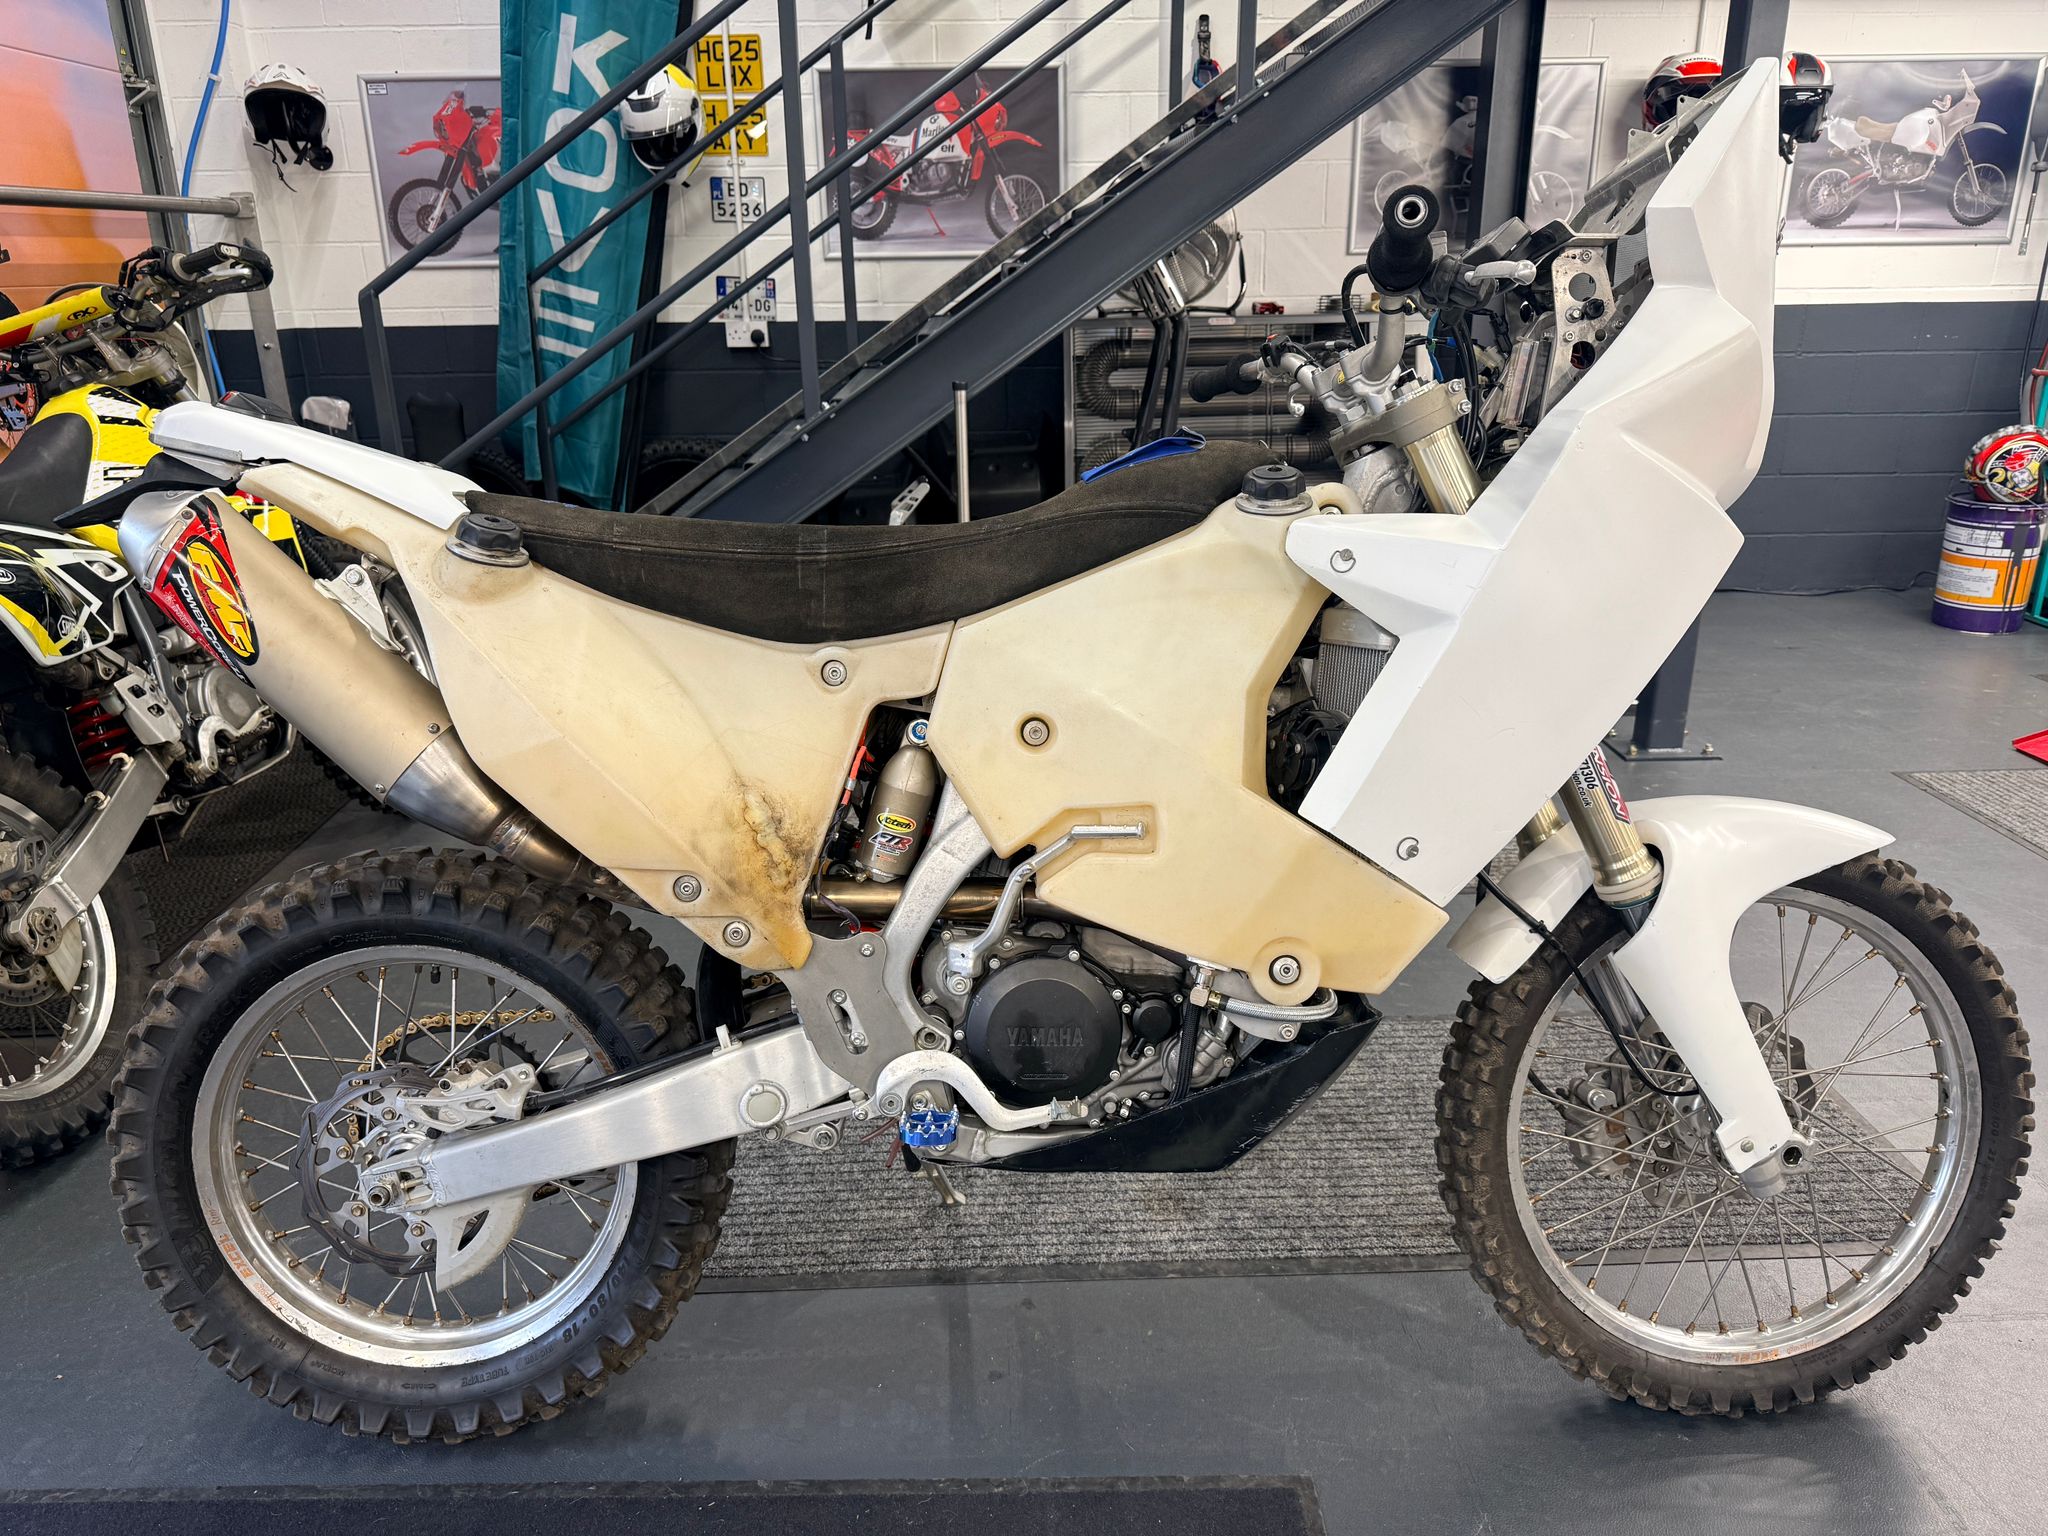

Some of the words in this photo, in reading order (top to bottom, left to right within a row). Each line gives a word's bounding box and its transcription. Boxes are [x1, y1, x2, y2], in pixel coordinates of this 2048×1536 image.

[941, 144, 955, 152] elf
[532, 12, 630, 359] KOVE
[713, 190, 722, 198] PL
[717, 202, 762, 217] 5236
[186, 540, 255, 653] FMF
[1006, 1027, 1084, 1047] YAMAHA
[218, 1233, 254, 1279] EXCEL
